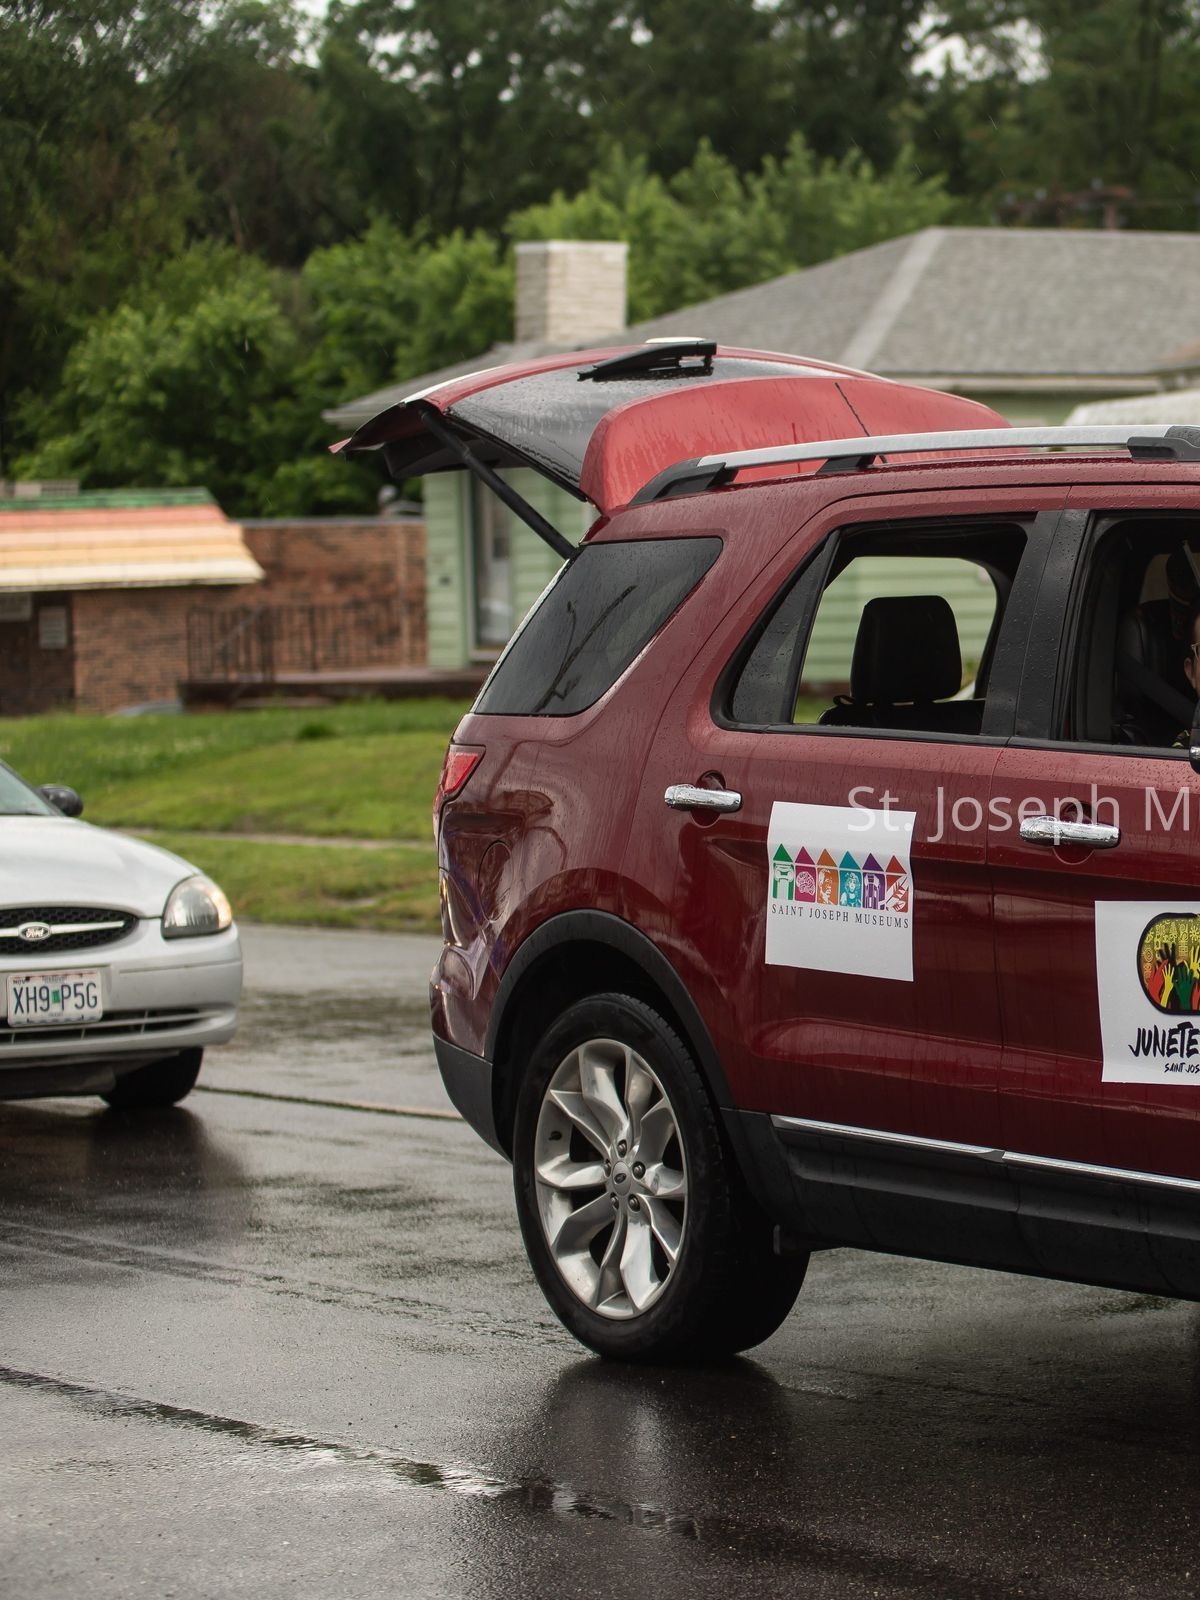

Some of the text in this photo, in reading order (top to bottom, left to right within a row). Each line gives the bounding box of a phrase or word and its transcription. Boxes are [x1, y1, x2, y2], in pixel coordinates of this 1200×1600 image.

[771, 904, 909, 929] SAINT JOSEPH MUSEUMS
[13, 982, 98, 1014] XH9 P5G
[1164, 1062, 1186, 1073] SAINT
